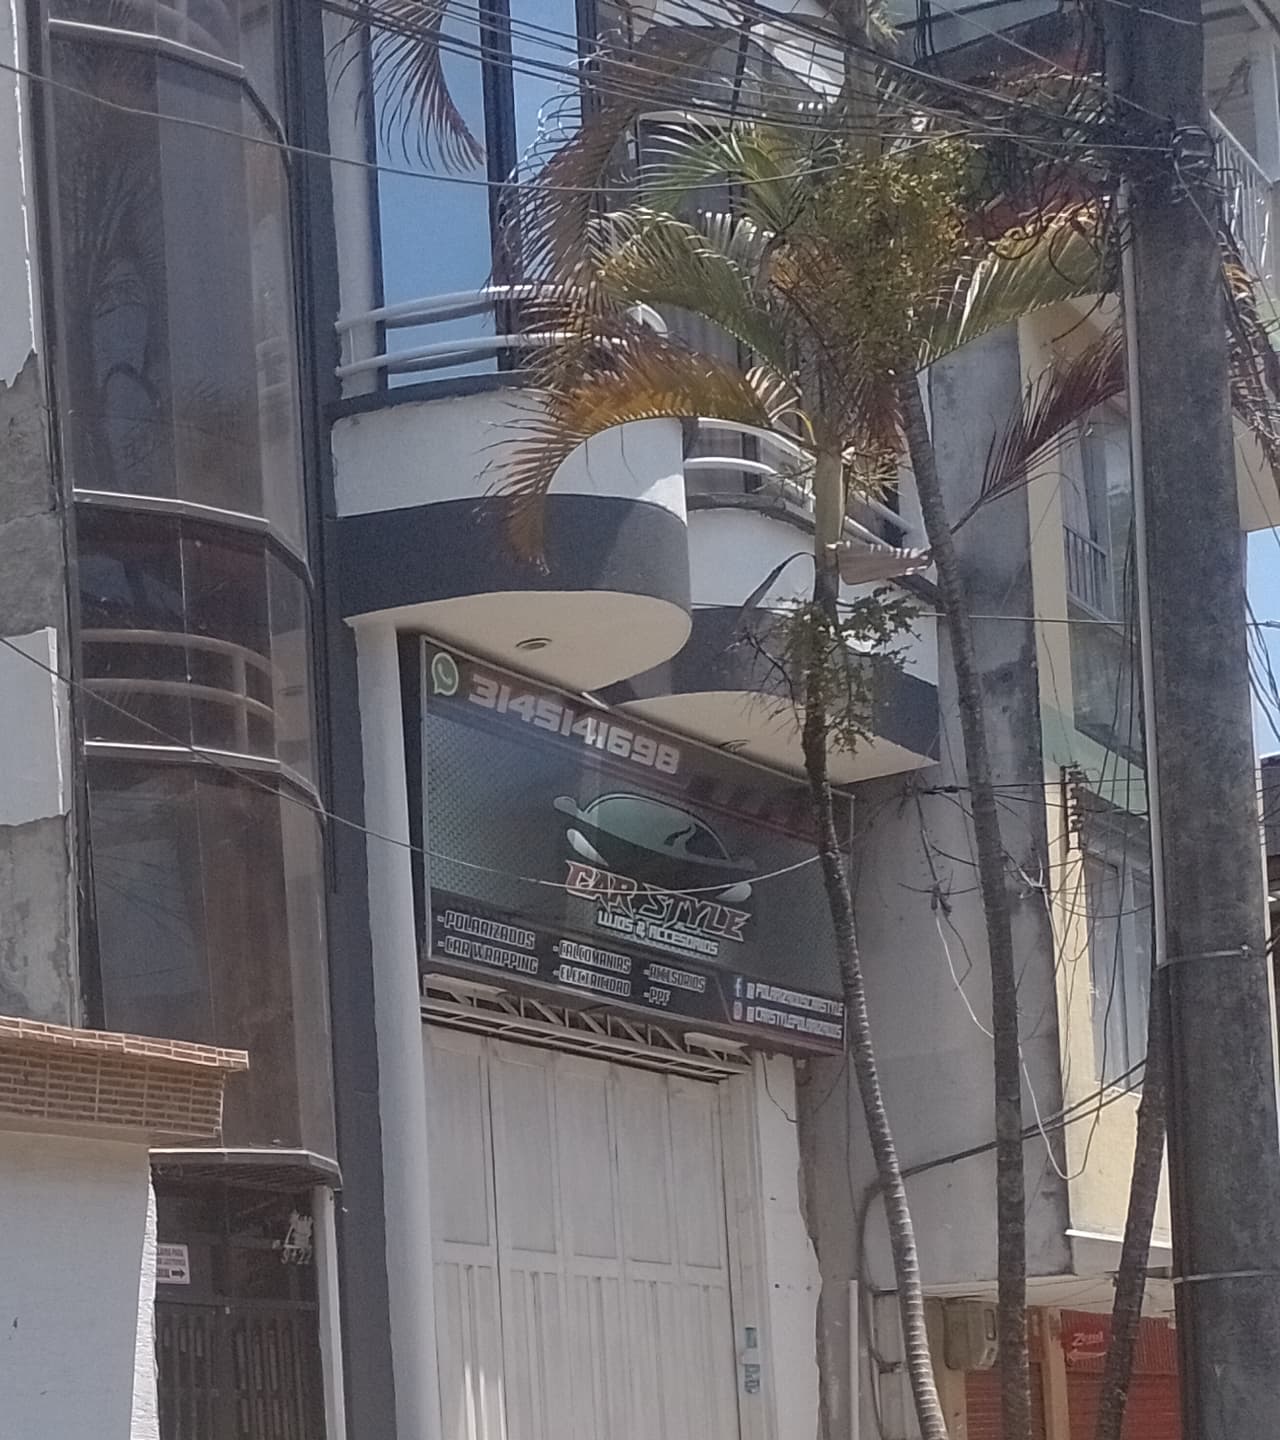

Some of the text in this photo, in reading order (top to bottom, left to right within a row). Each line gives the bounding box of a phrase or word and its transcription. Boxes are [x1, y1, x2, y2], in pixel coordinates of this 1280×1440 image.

[469, 673, 680, 775] 3145141698
[565, 860, 752, 942] CAR STYLE
